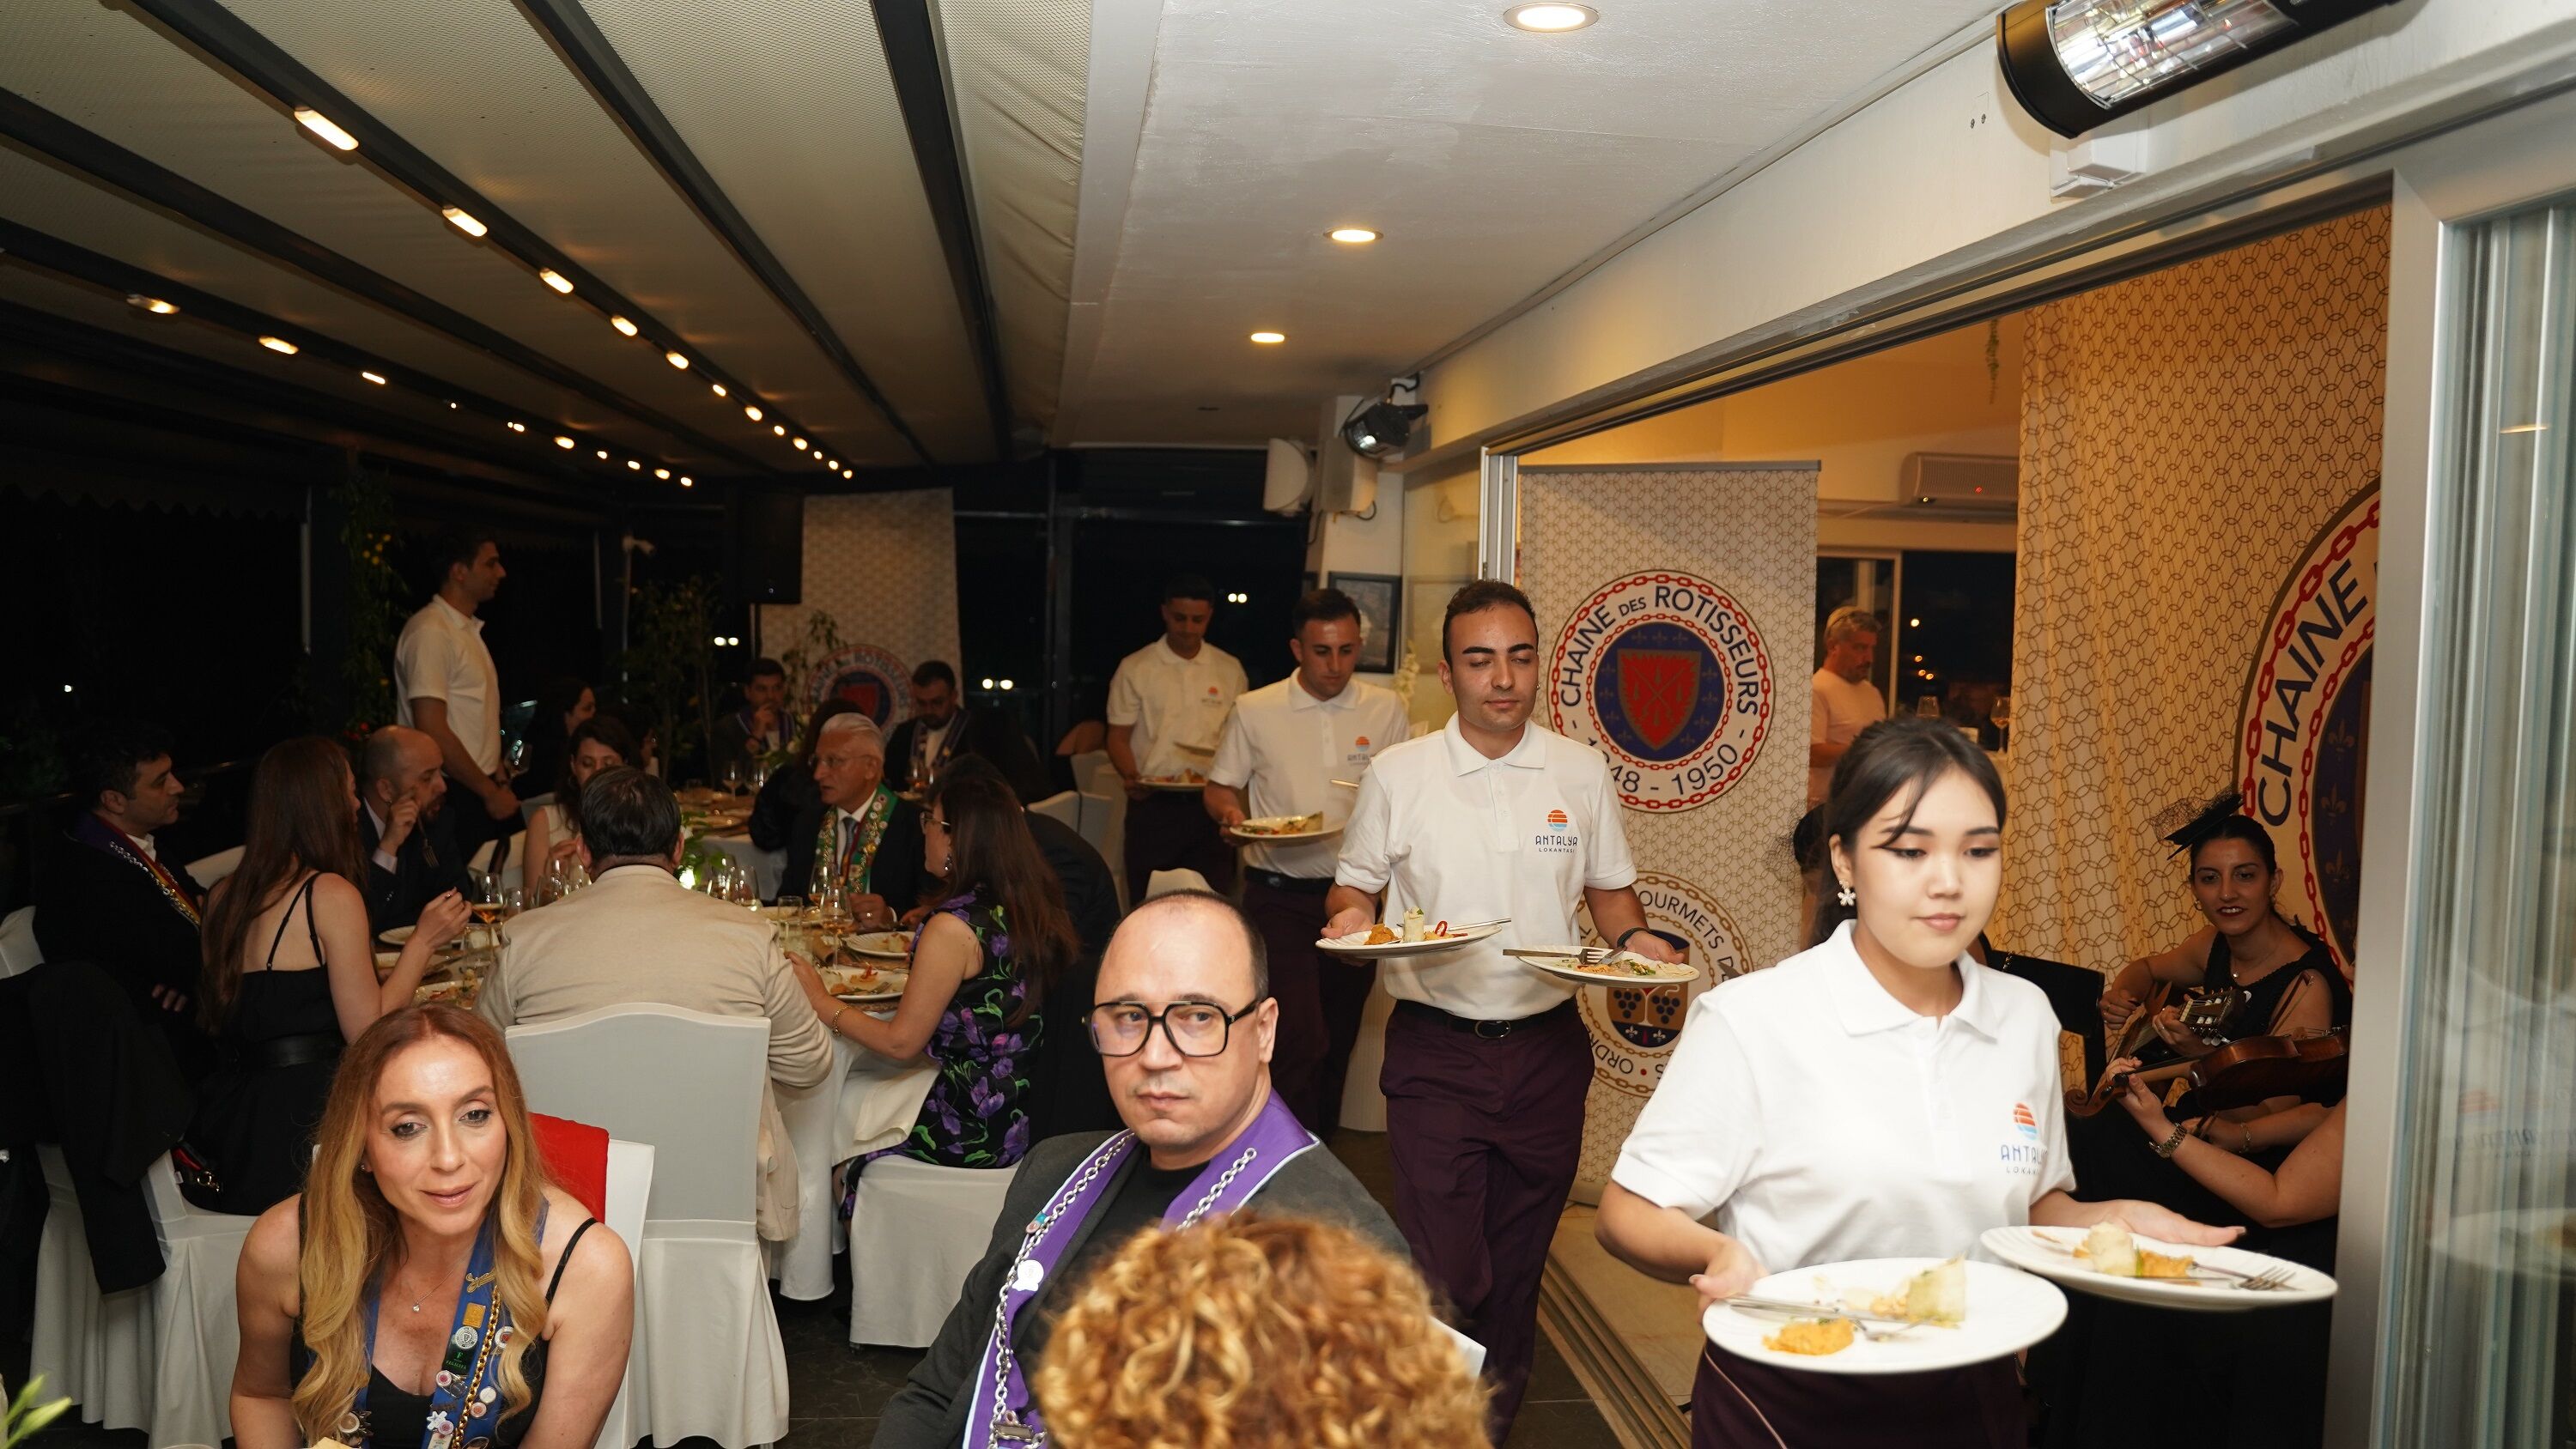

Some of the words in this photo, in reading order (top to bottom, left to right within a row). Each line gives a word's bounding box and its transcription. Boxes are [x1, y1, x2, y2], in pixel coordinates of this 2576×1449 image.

[1560, 604, 1616, 706] CHAINE
[1619, 597, 1647, 616] DES
[1655, 585, 1759, 716] ROTISSEURS
[2258, 558, 2368, 827] CHAINE
[1671, 743, 1738, 795] 1950
[1535, 835, 1578, 846] ANTALYA
[1638, 889, 1724, 949] OURMETS
[2001, 1144, 2048, 1165] ANTAL
